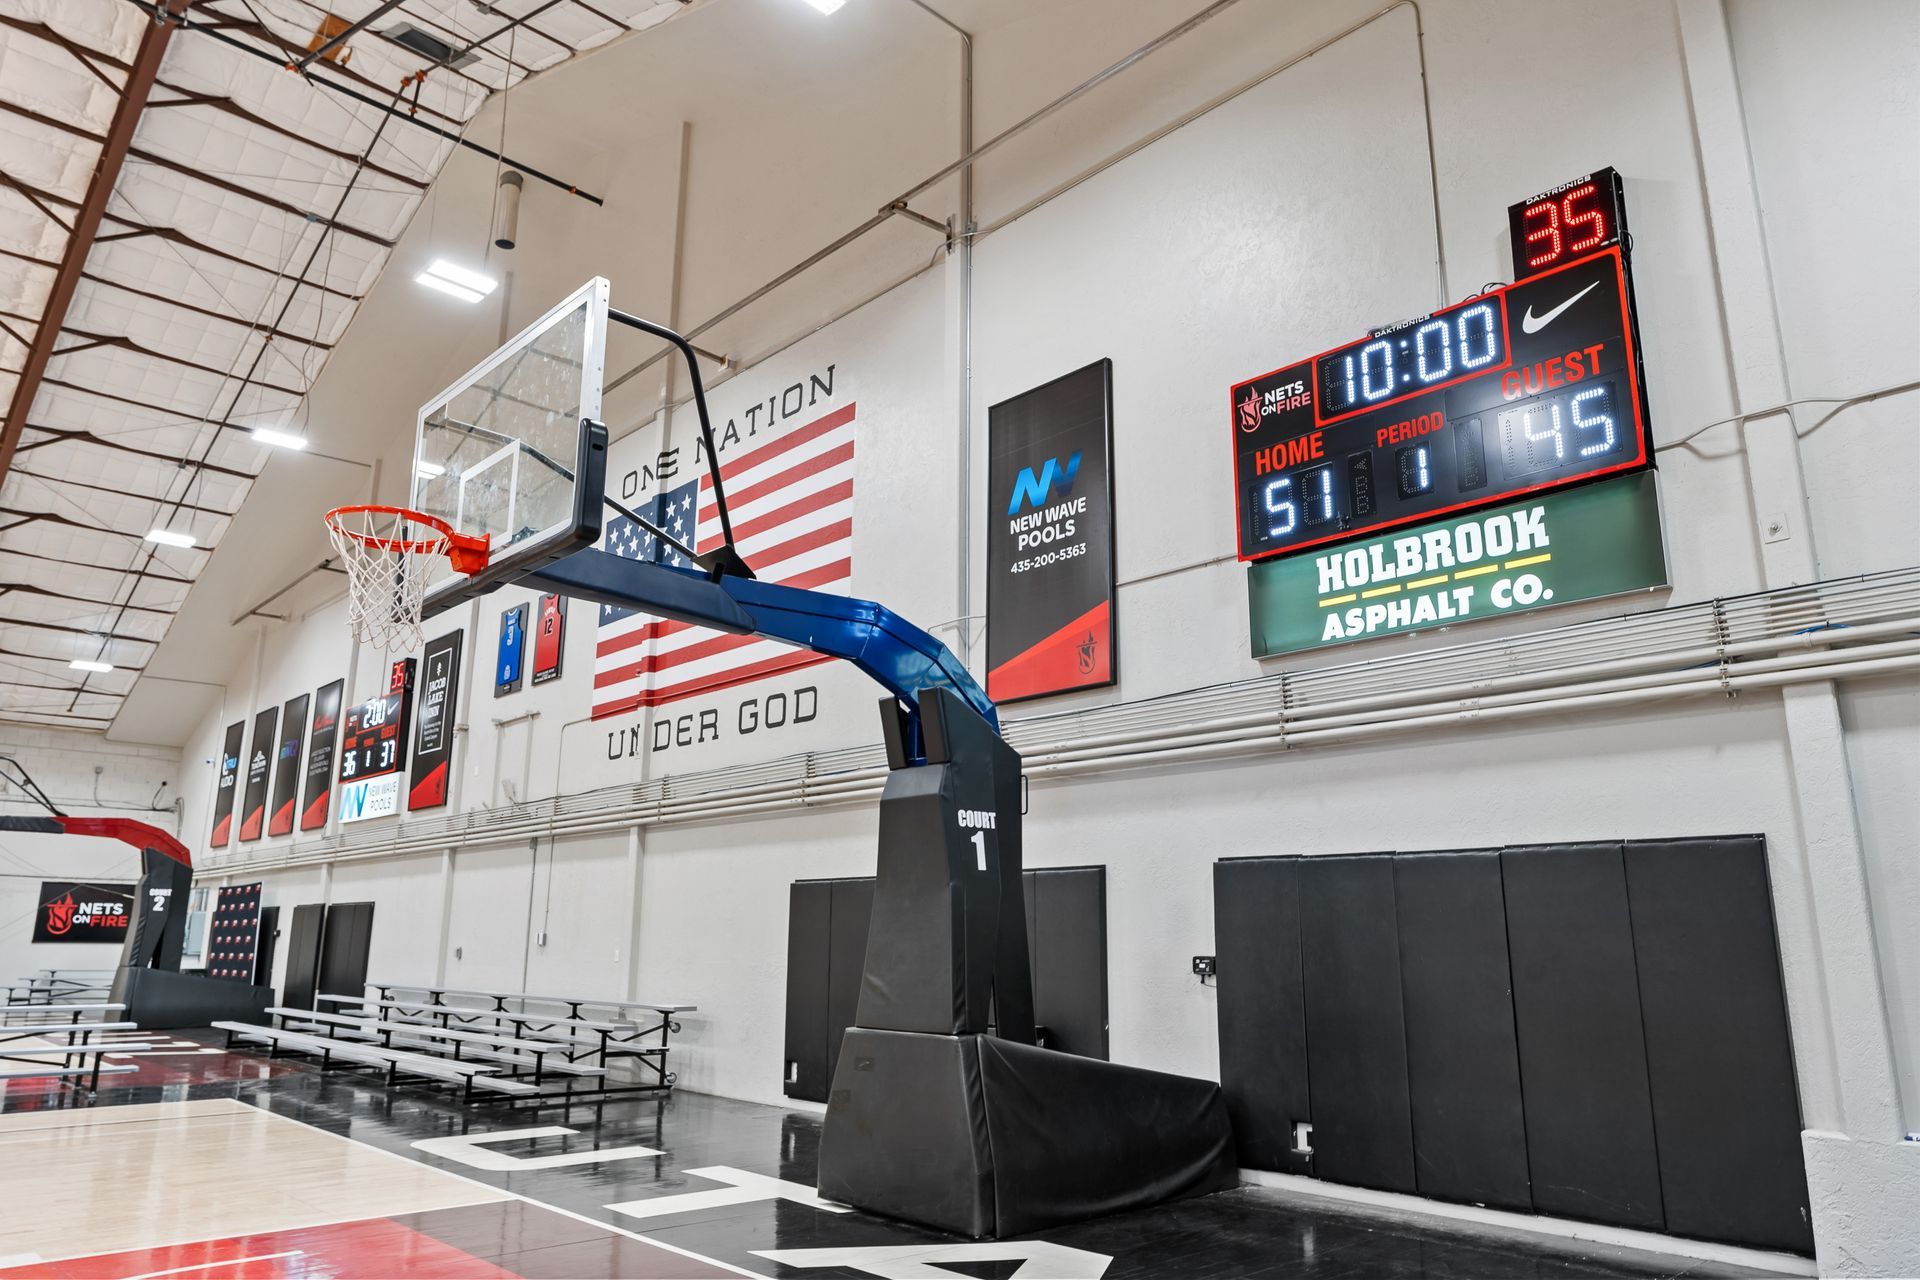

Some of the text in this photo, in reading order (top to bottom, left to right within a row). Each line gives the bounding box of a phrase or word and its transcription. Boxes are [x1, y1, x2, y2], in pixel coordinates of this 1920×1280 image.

[1526, 174, 1591, 205] DAKTRONICS
[1525, 186, 1604, 267] 35
[1374, 314, 1431, 339] DAKTRONICS
[1345, 304, 1496, 404] 10:00
[1501, 343, 1604, 401] GUEST
[1264, 380, 1304, 405] NETS
[622, 364, 836, 499] ONE NATION
[1376, 411, 1444, 449] PERIOD
[1523, 387, 1615, 459] 45
[1255, 431, 1325, 476] HOME
[1417, 448, 1428, 488] 1
[1010, 497, 1087, 534] NEW WAVE
[1265, 470, 1331, 537] 51
[1018, 519, 1075, 552] POOLS
[1316, 507, 1551, 595] HOLBROOK
[1010, 543, 1087, 574] 435-200-5363
[1321, 573, 1554, 642] ASPHALT CO.
[608, 685, 818, 760] UNDER GOD
[957, 809, 996, 829] COURT
[970, 830, 987, 871] 1
[78, 902, 123, 916] NETS
[152, 896, 164, 912] 2
